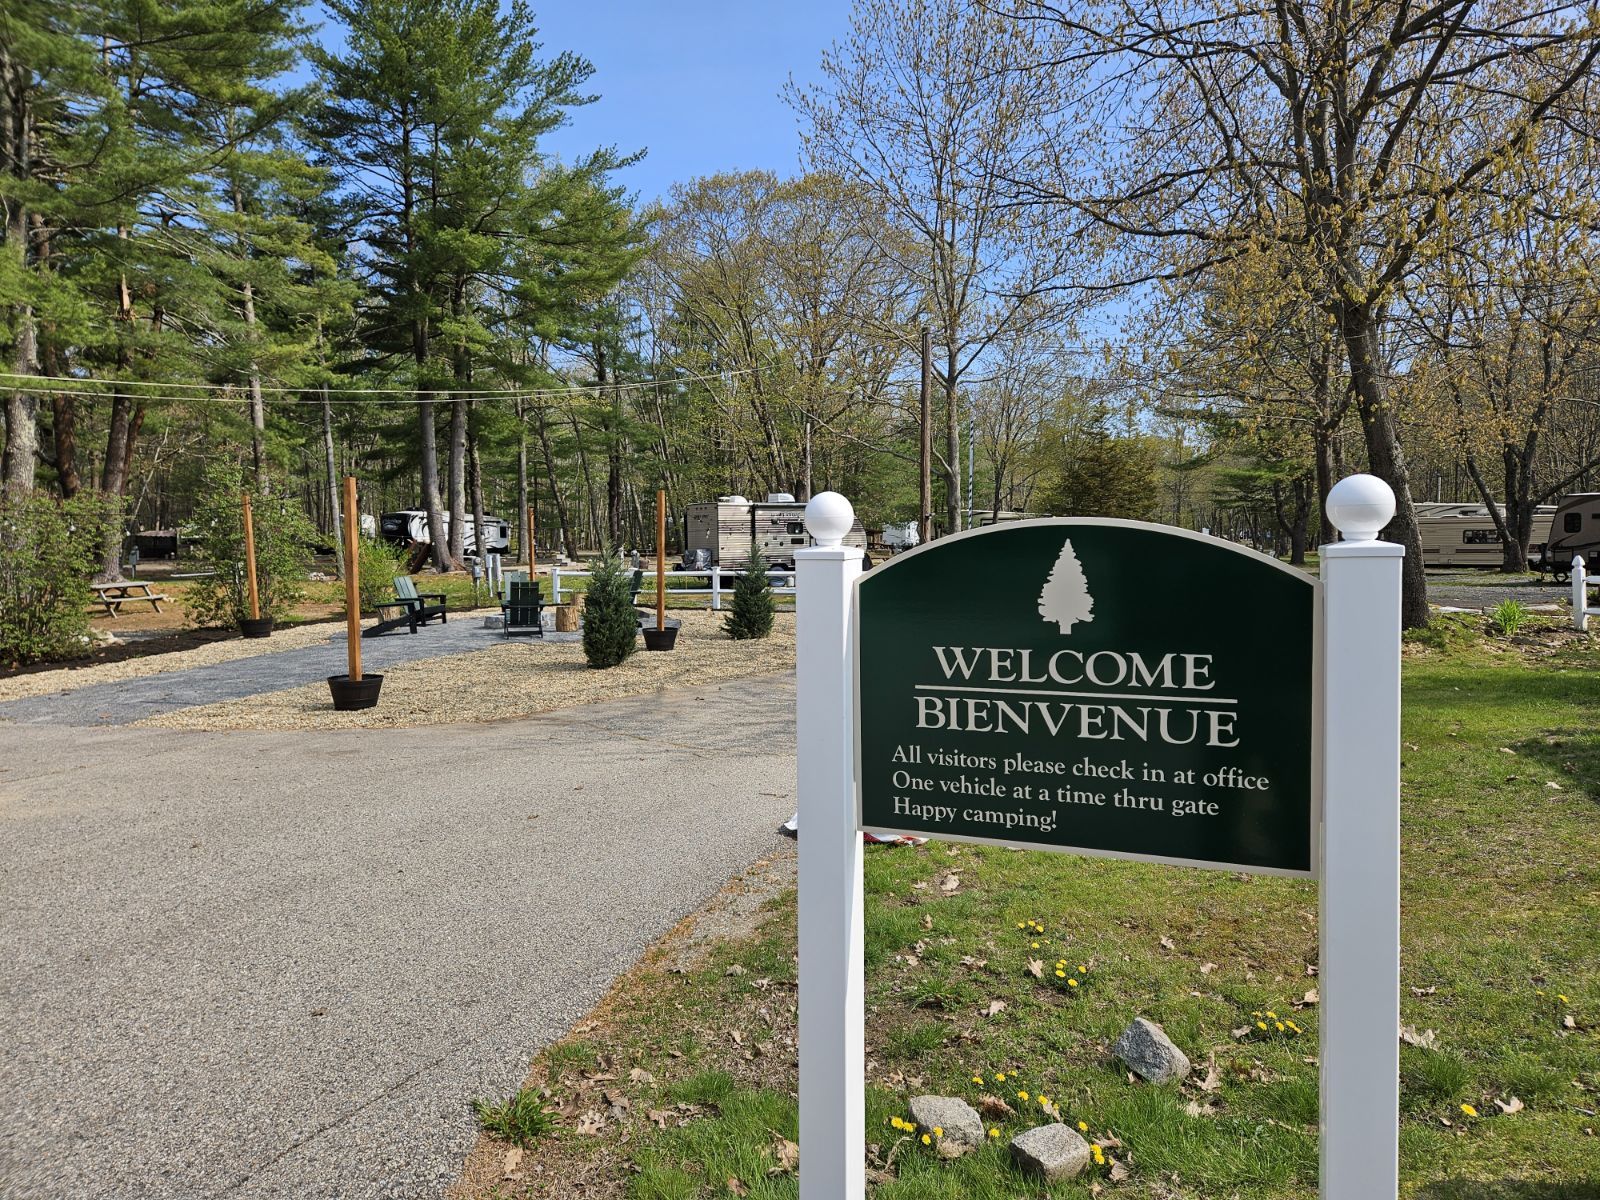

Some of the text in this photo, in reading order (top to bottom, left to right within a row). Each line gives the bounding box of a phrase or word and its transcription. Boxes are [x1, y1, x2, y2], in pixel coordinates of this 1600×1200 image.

[932, 645, 1216, 690] WELCOME
[913, 696, 1240, 748] BIENVENUE
[891, 744, 1270, 791] All visitors please check in at office
[892, 770, 1219, 817] One vehicle at a time thru gate
[892, 796, 1058, 833] Happy camping!
